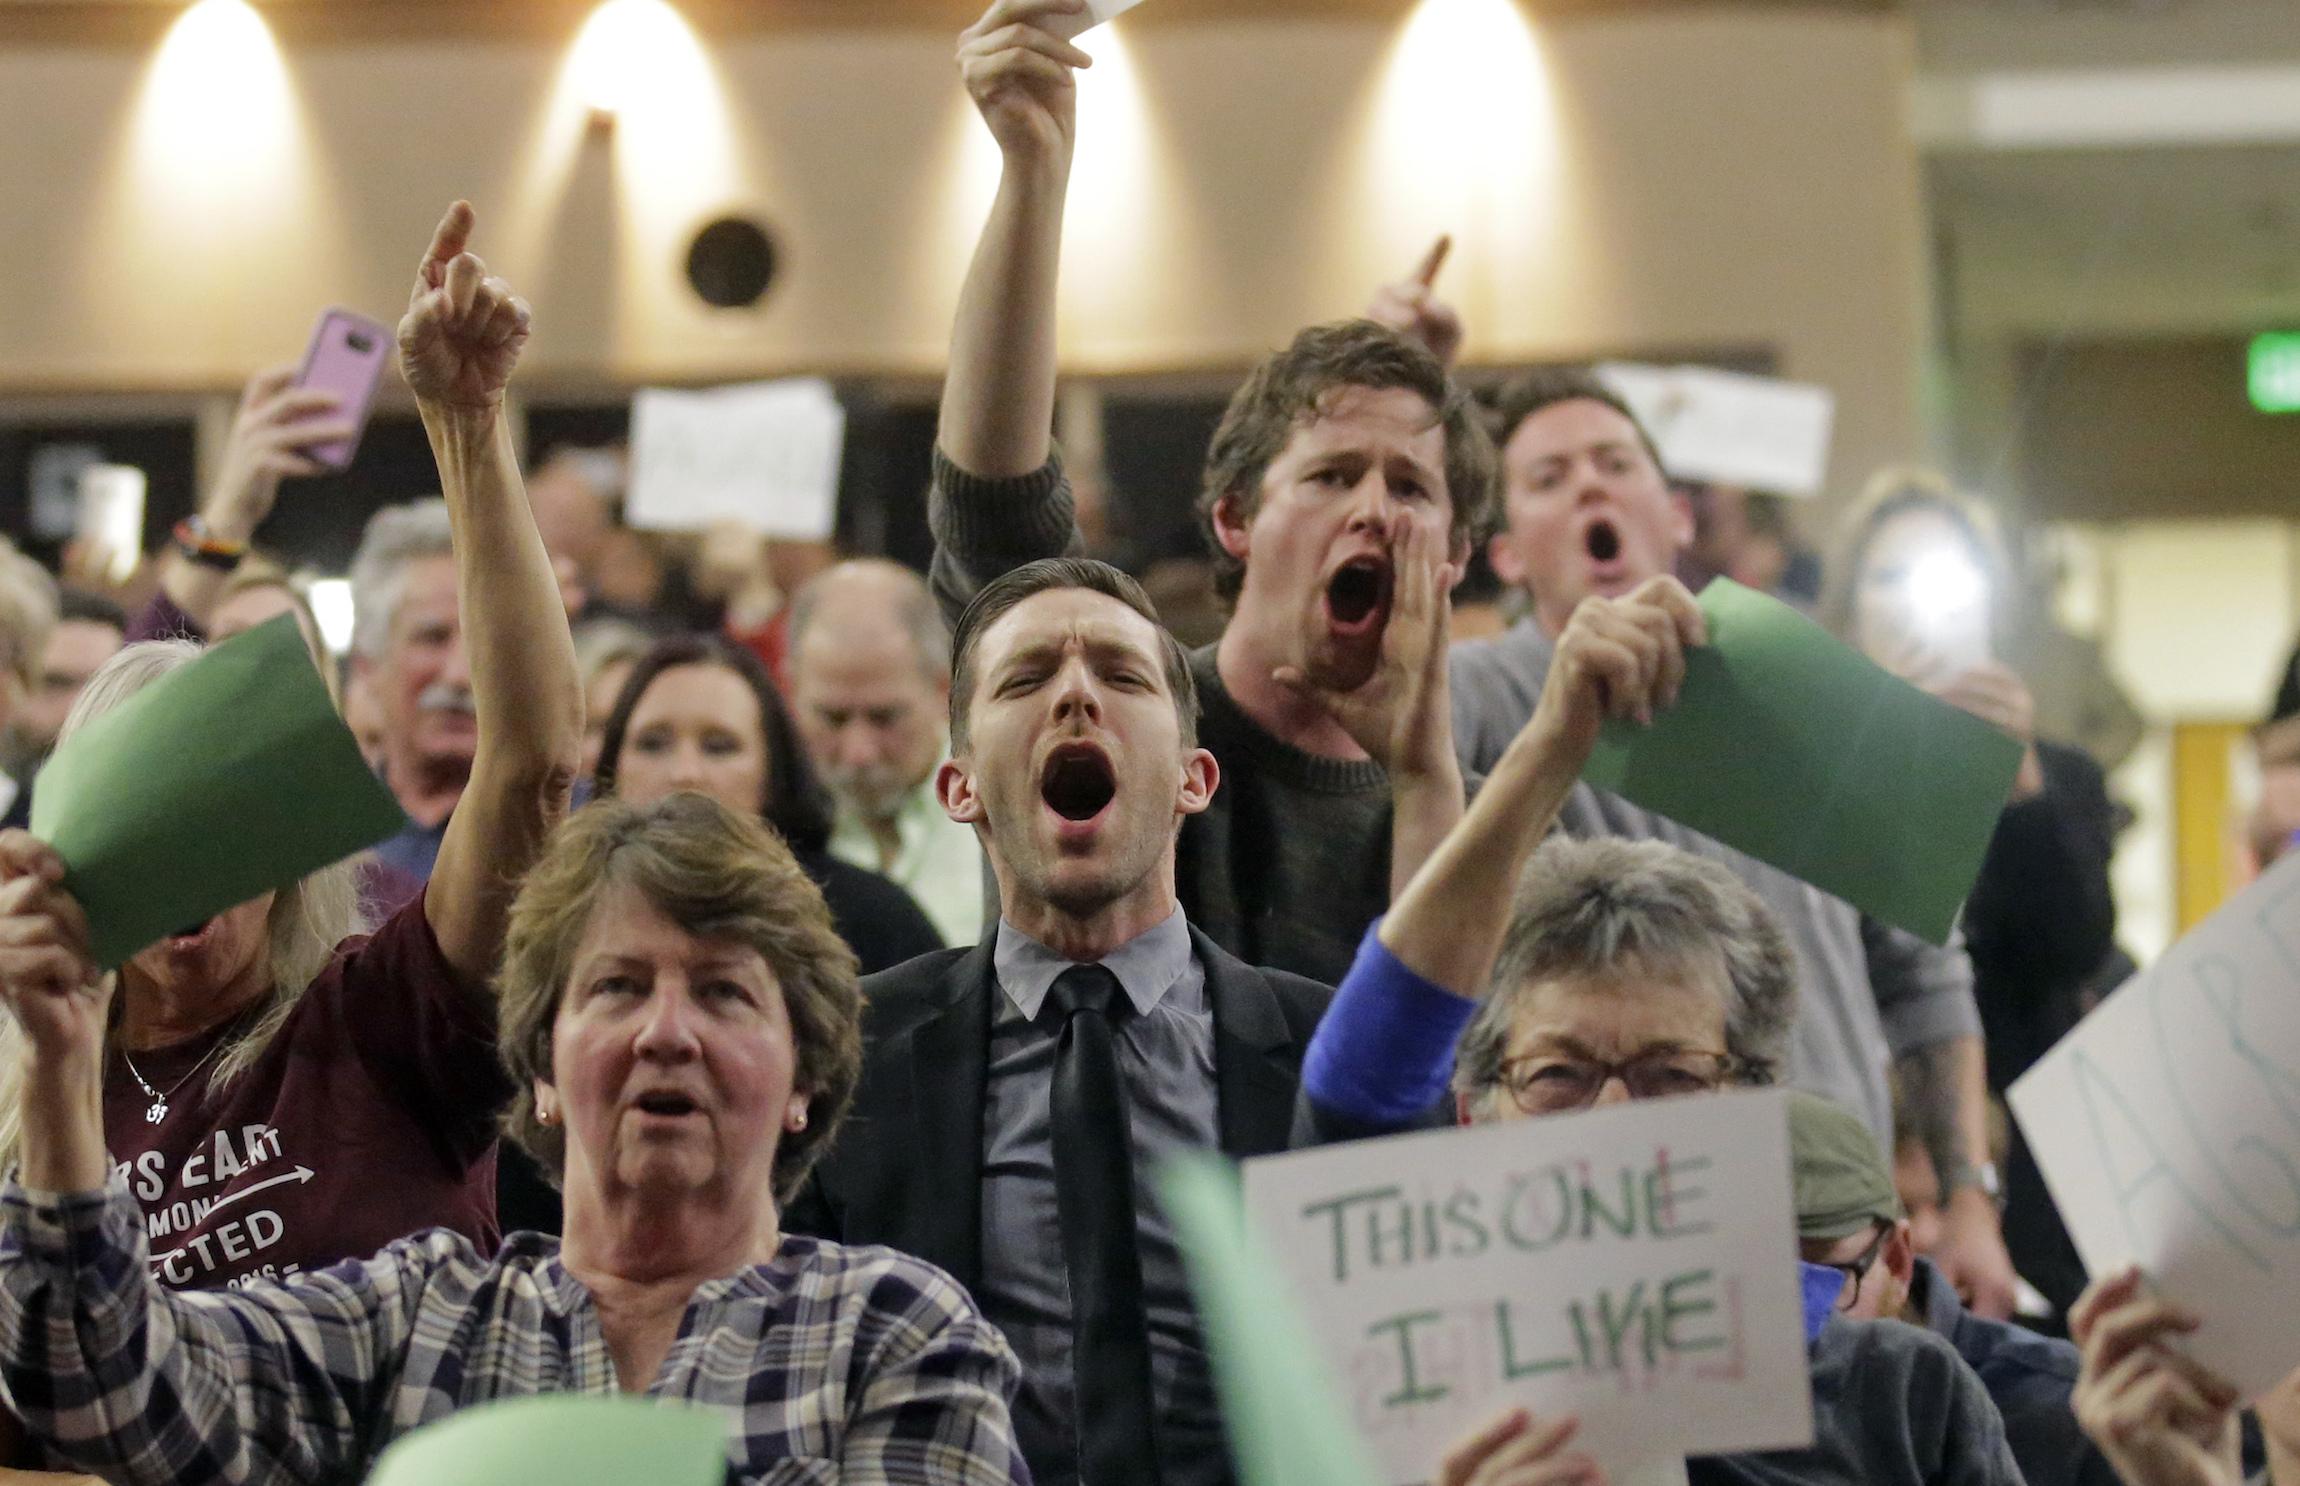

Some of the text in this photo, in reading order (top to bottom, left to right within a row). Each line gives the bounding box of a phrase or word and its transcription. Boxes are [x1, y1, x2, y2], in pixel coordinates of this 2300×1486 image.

[150, 1209, 284, 1285] CTED
[1303, 1155, 1713, 1284] THIS ONE
[1365, 1308, 1453, 1408] I
